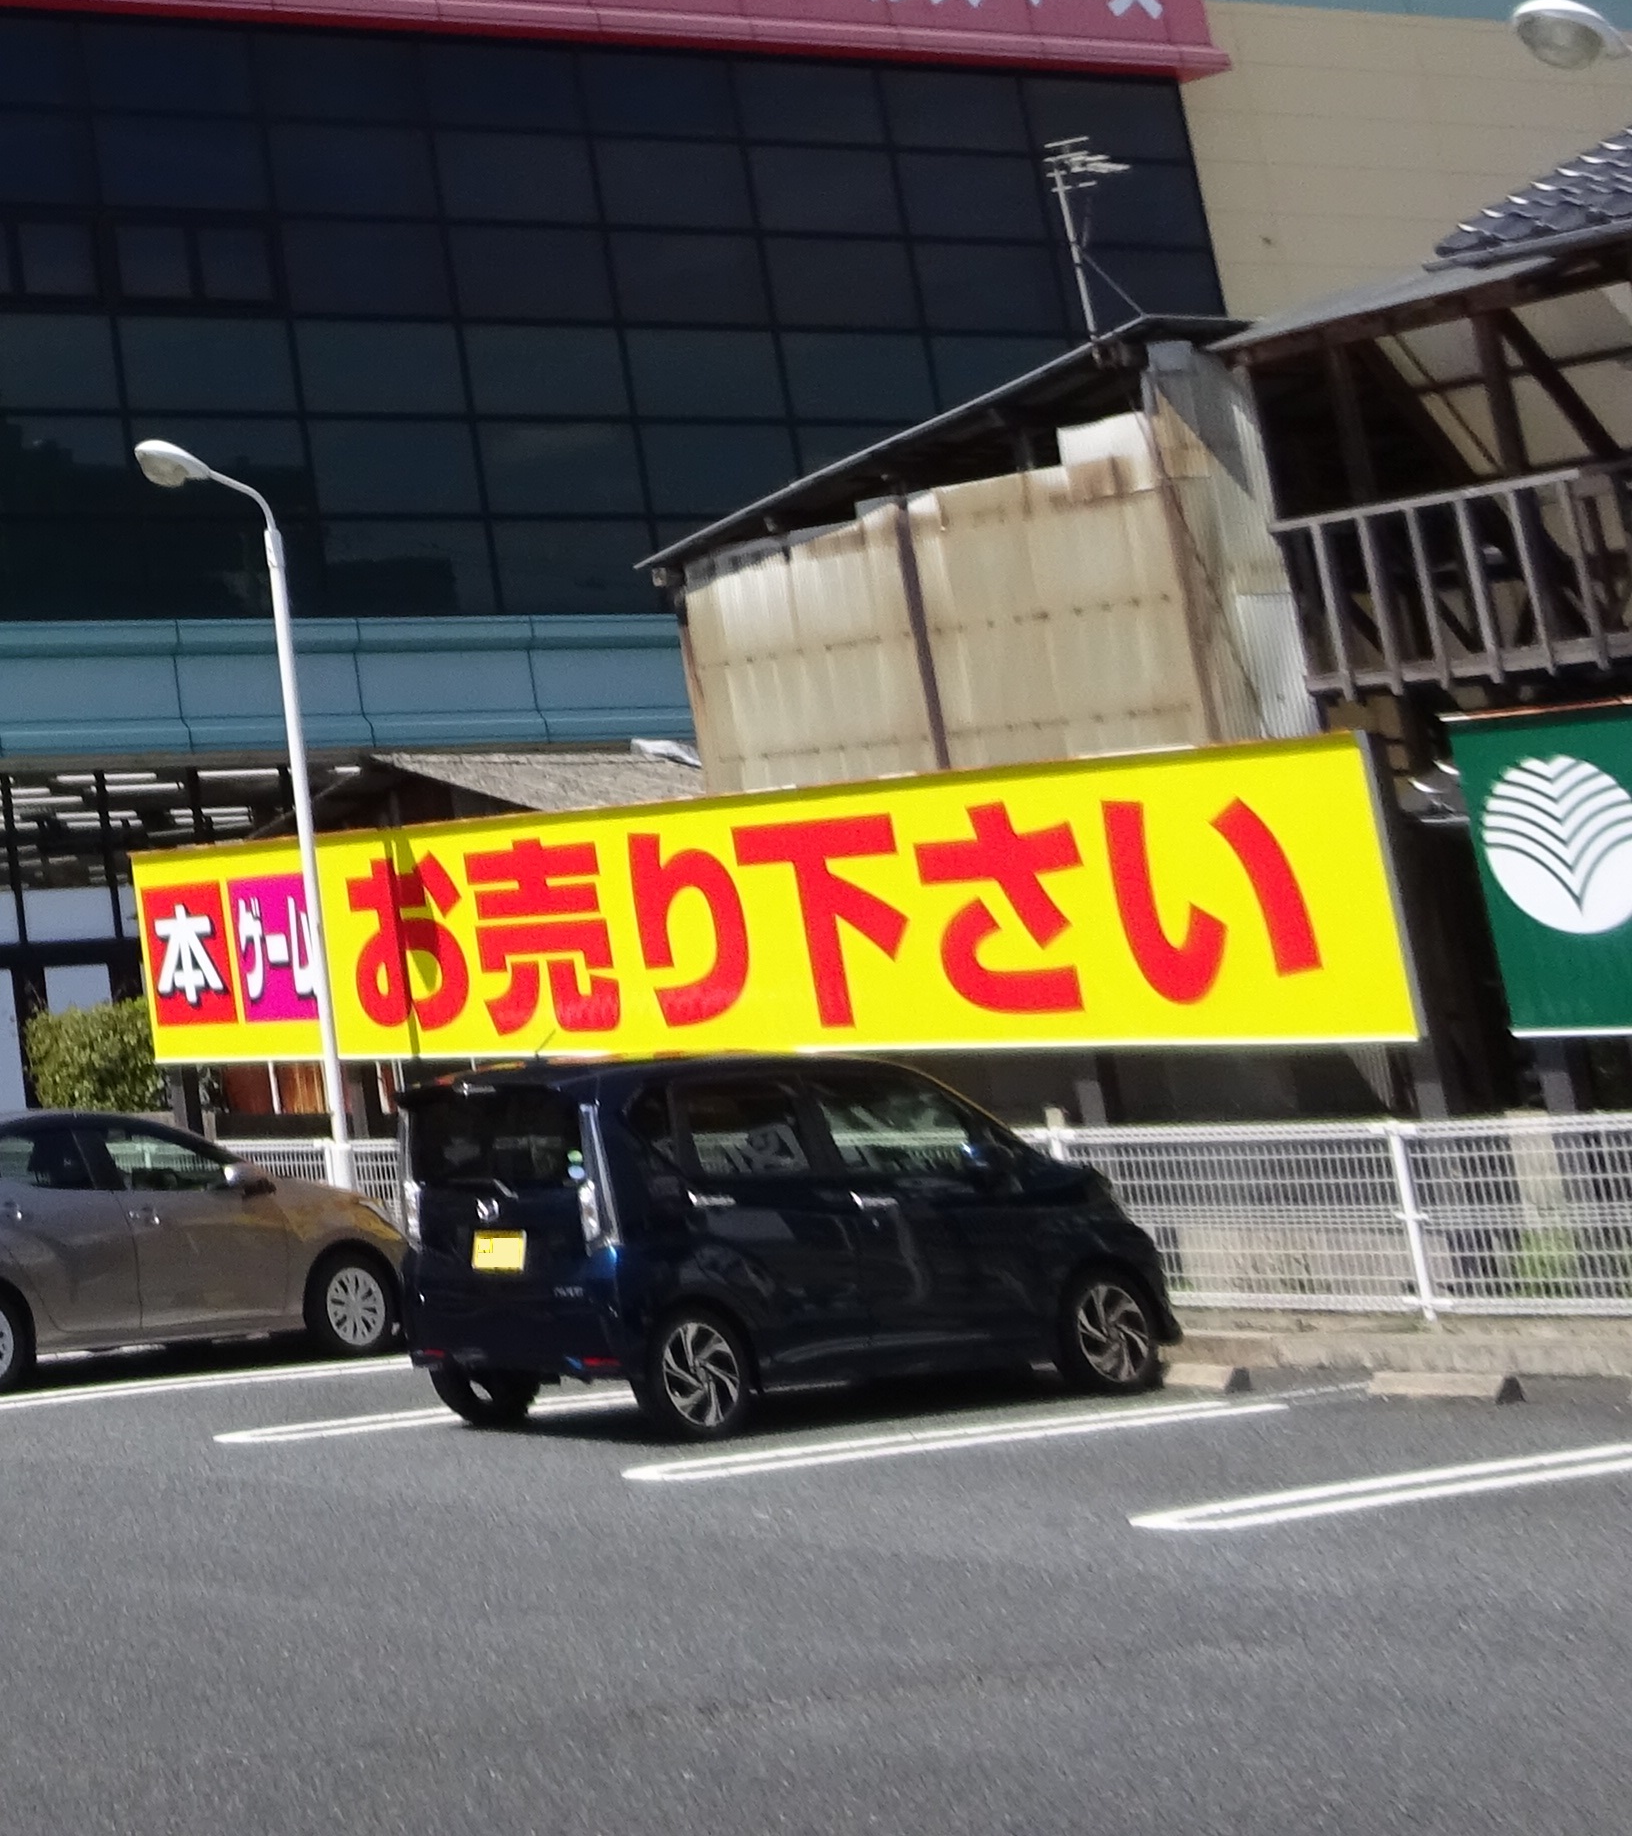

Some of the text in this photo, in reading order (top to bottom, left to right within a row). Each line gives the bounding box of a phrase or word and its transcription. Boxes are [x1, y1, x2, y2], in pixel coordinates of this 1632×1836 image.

[152, 796, 1324, 1038] 本 ゲーム お売り下さい
